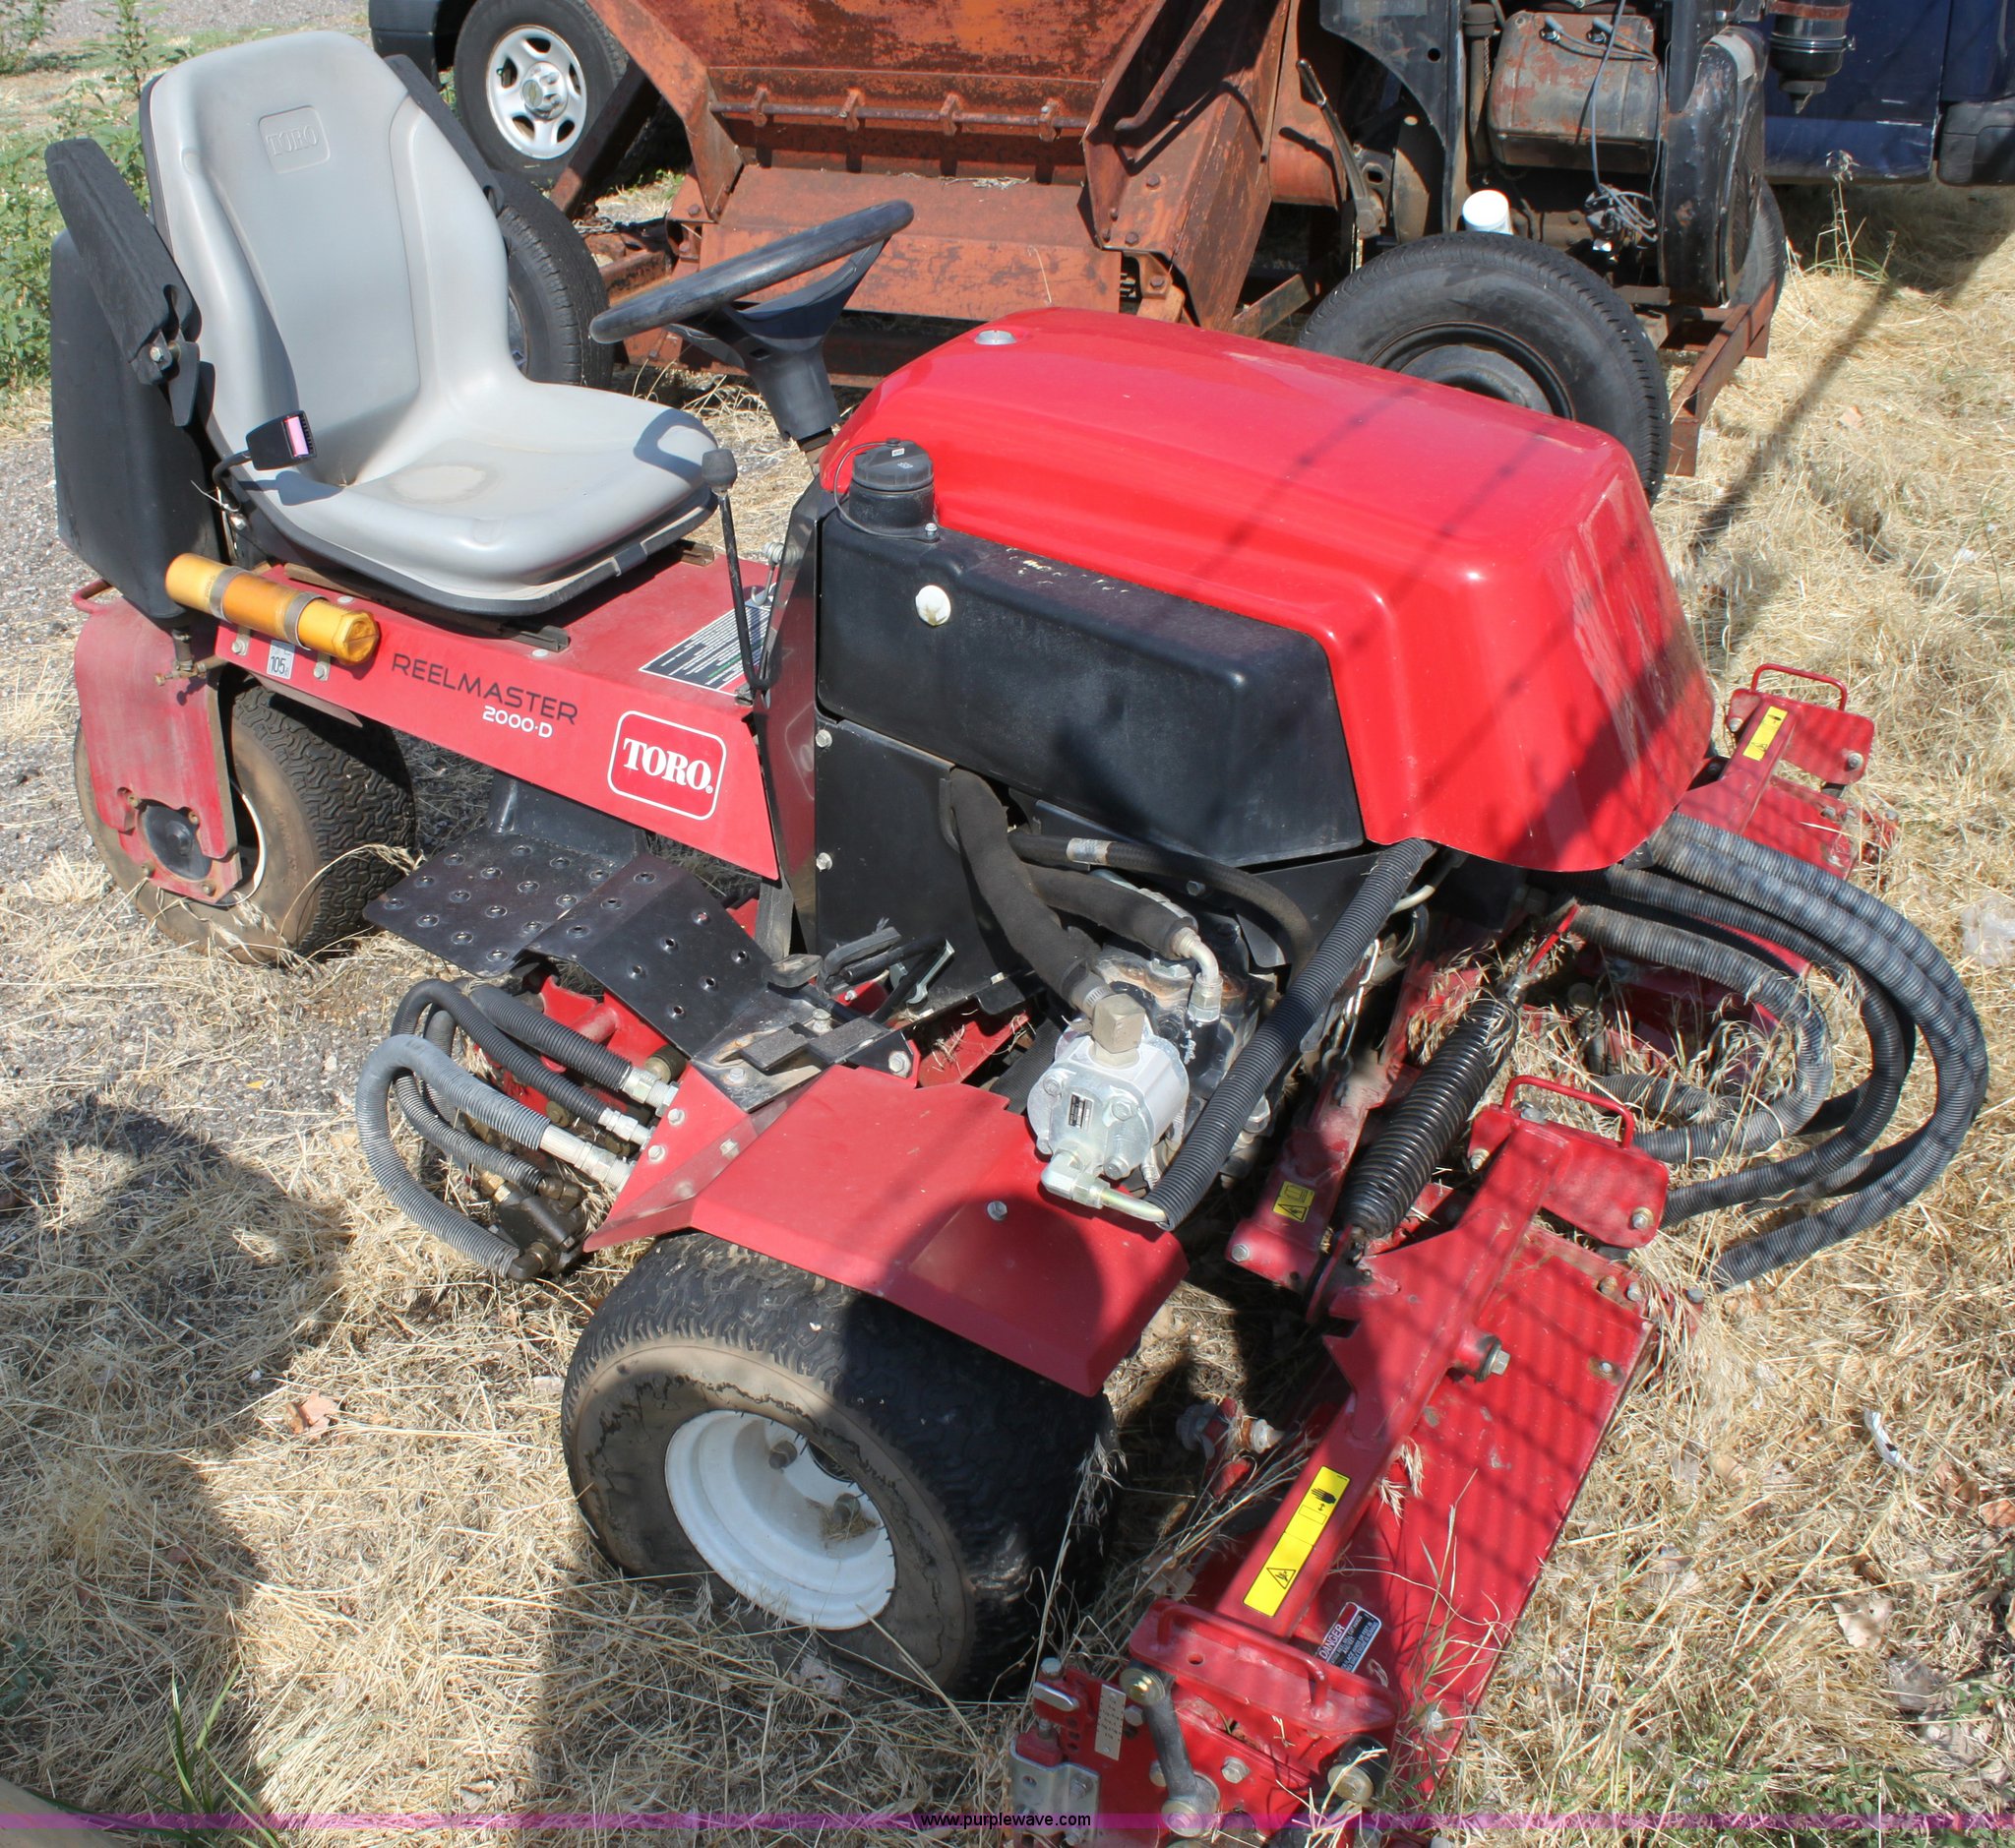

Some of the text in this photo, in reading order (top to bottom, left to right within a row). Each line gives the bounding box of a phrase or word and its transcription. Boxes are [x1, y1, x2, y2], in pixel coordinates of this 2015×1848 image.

[265, 125, 317, 155] TORO
[270, 656, 287, 674] 105
[392, 653, 579, 725] REELMASTER
[622, 737, 711, 790] TORO
[1319, 1624, 1345, 1659] DANGER
